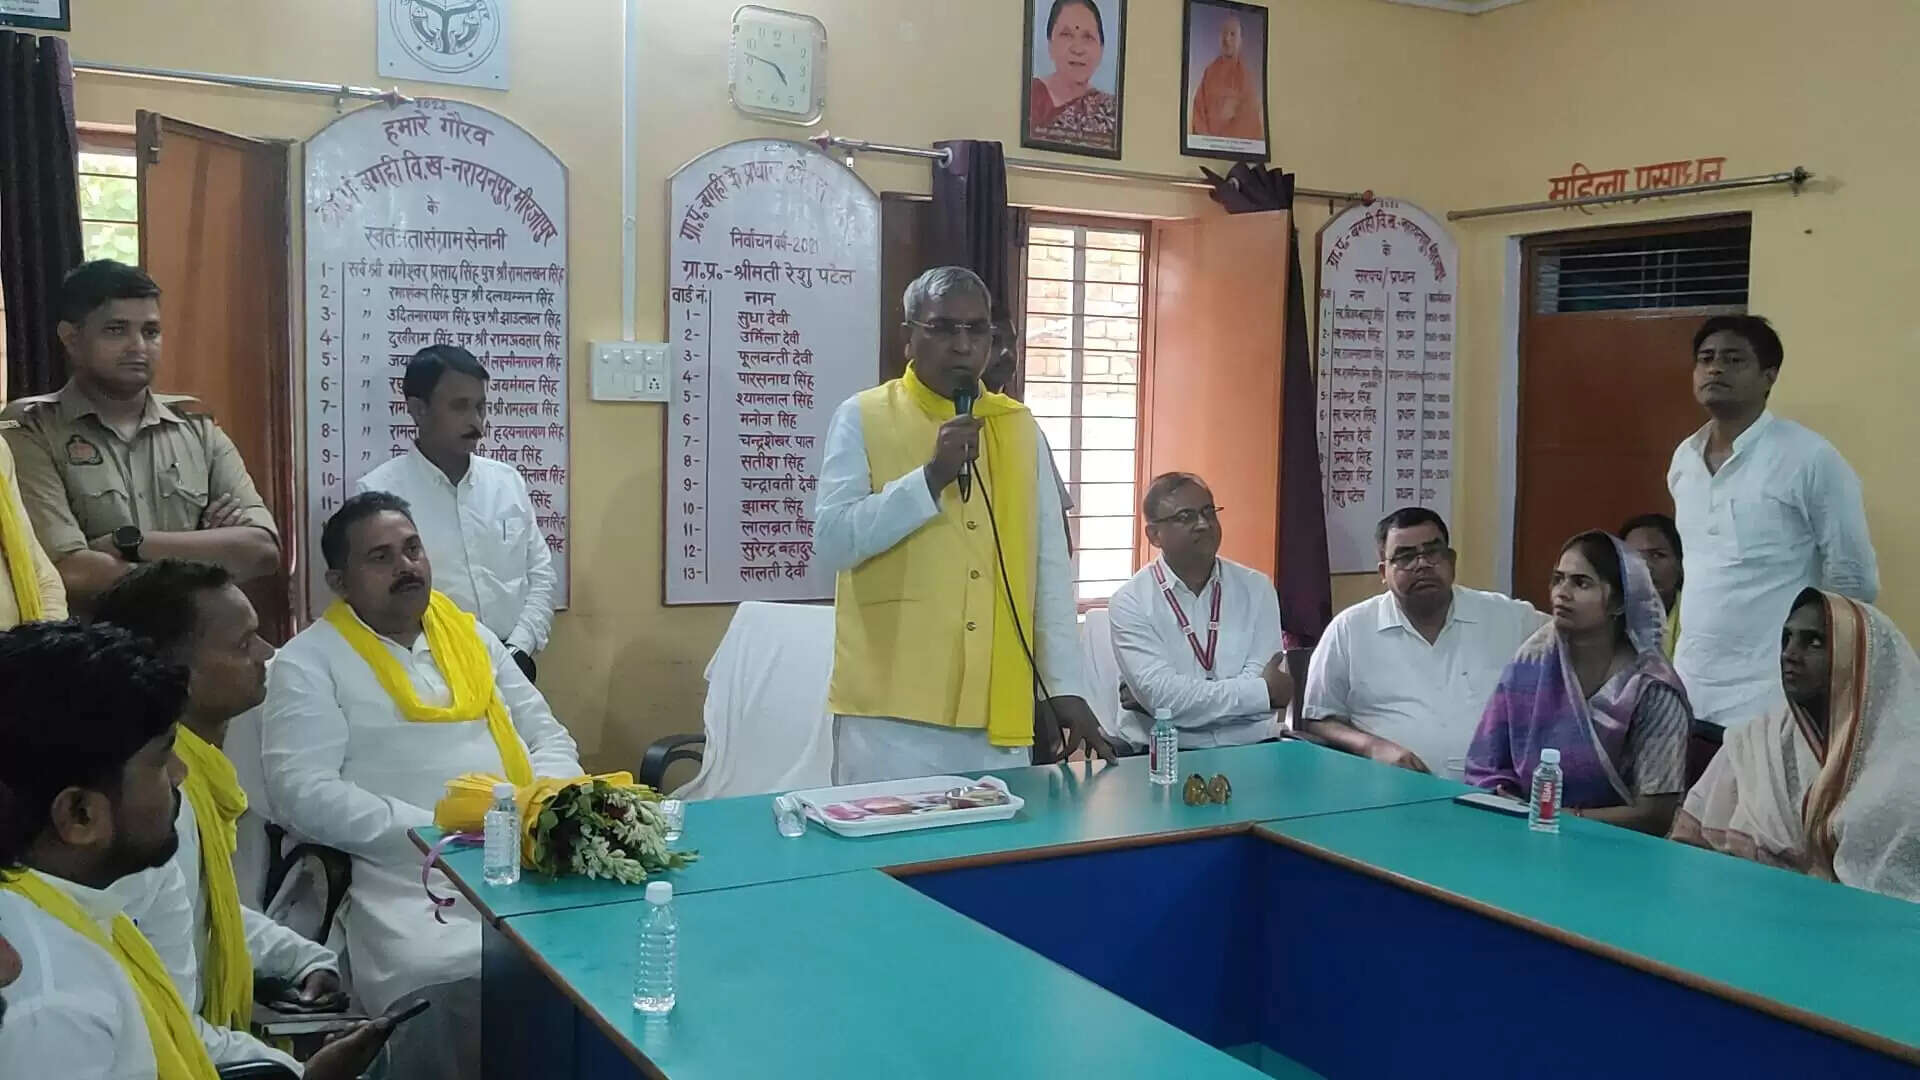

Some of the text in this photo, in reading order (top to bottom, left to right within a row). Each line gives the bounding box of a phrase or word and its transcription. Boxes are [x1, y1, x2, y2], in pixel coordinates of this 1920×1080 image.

[382, 110, 495, 147] हमारे गौरव
[424, 194, 440, 215] के
[785, 262, 814, 289] रेशु
[815, 263, 857, 286] पटेल
[744, 290, 777, 307] नाम
[686, 309, 791, 329] 1- सुधा देवी
[684, 329, 700, 341] 2-
[783, 329, 801, 346] देवी
[683, 350, 700, 361] 3-
[792, 348, 814, 366] देवी
[682, 370, 700, 383] 4-
[792, 369, 815, 390] सिंह
[683, 390, 814, 409] 5- श्यामलाल सिंह
[682, 408, 799, 429] 6- मनोज सिंह
[683, 435, 700, 446] 7-
[793, 435, 816, 450] पाल
[521, 443, 545, 465] सिंह
[683, 451, 806, 473] 8- सतीश सिंह
[683, 477, 699, 492] 9-
[797, 474, 819, 494] देवी
[528, 489, 554, 510] सिंह
[683, 501, 703, 515] 10-
[782, 497, 804, 518] सिंह
[683, 522, 701, 537] 11-
[795, 516, 815, 538] सिंह
[683, 543, 702, 558] 12-
[778, 541, 816, 561] बहादुर
[683, 561, 809, 584] 13- लालती देवी
